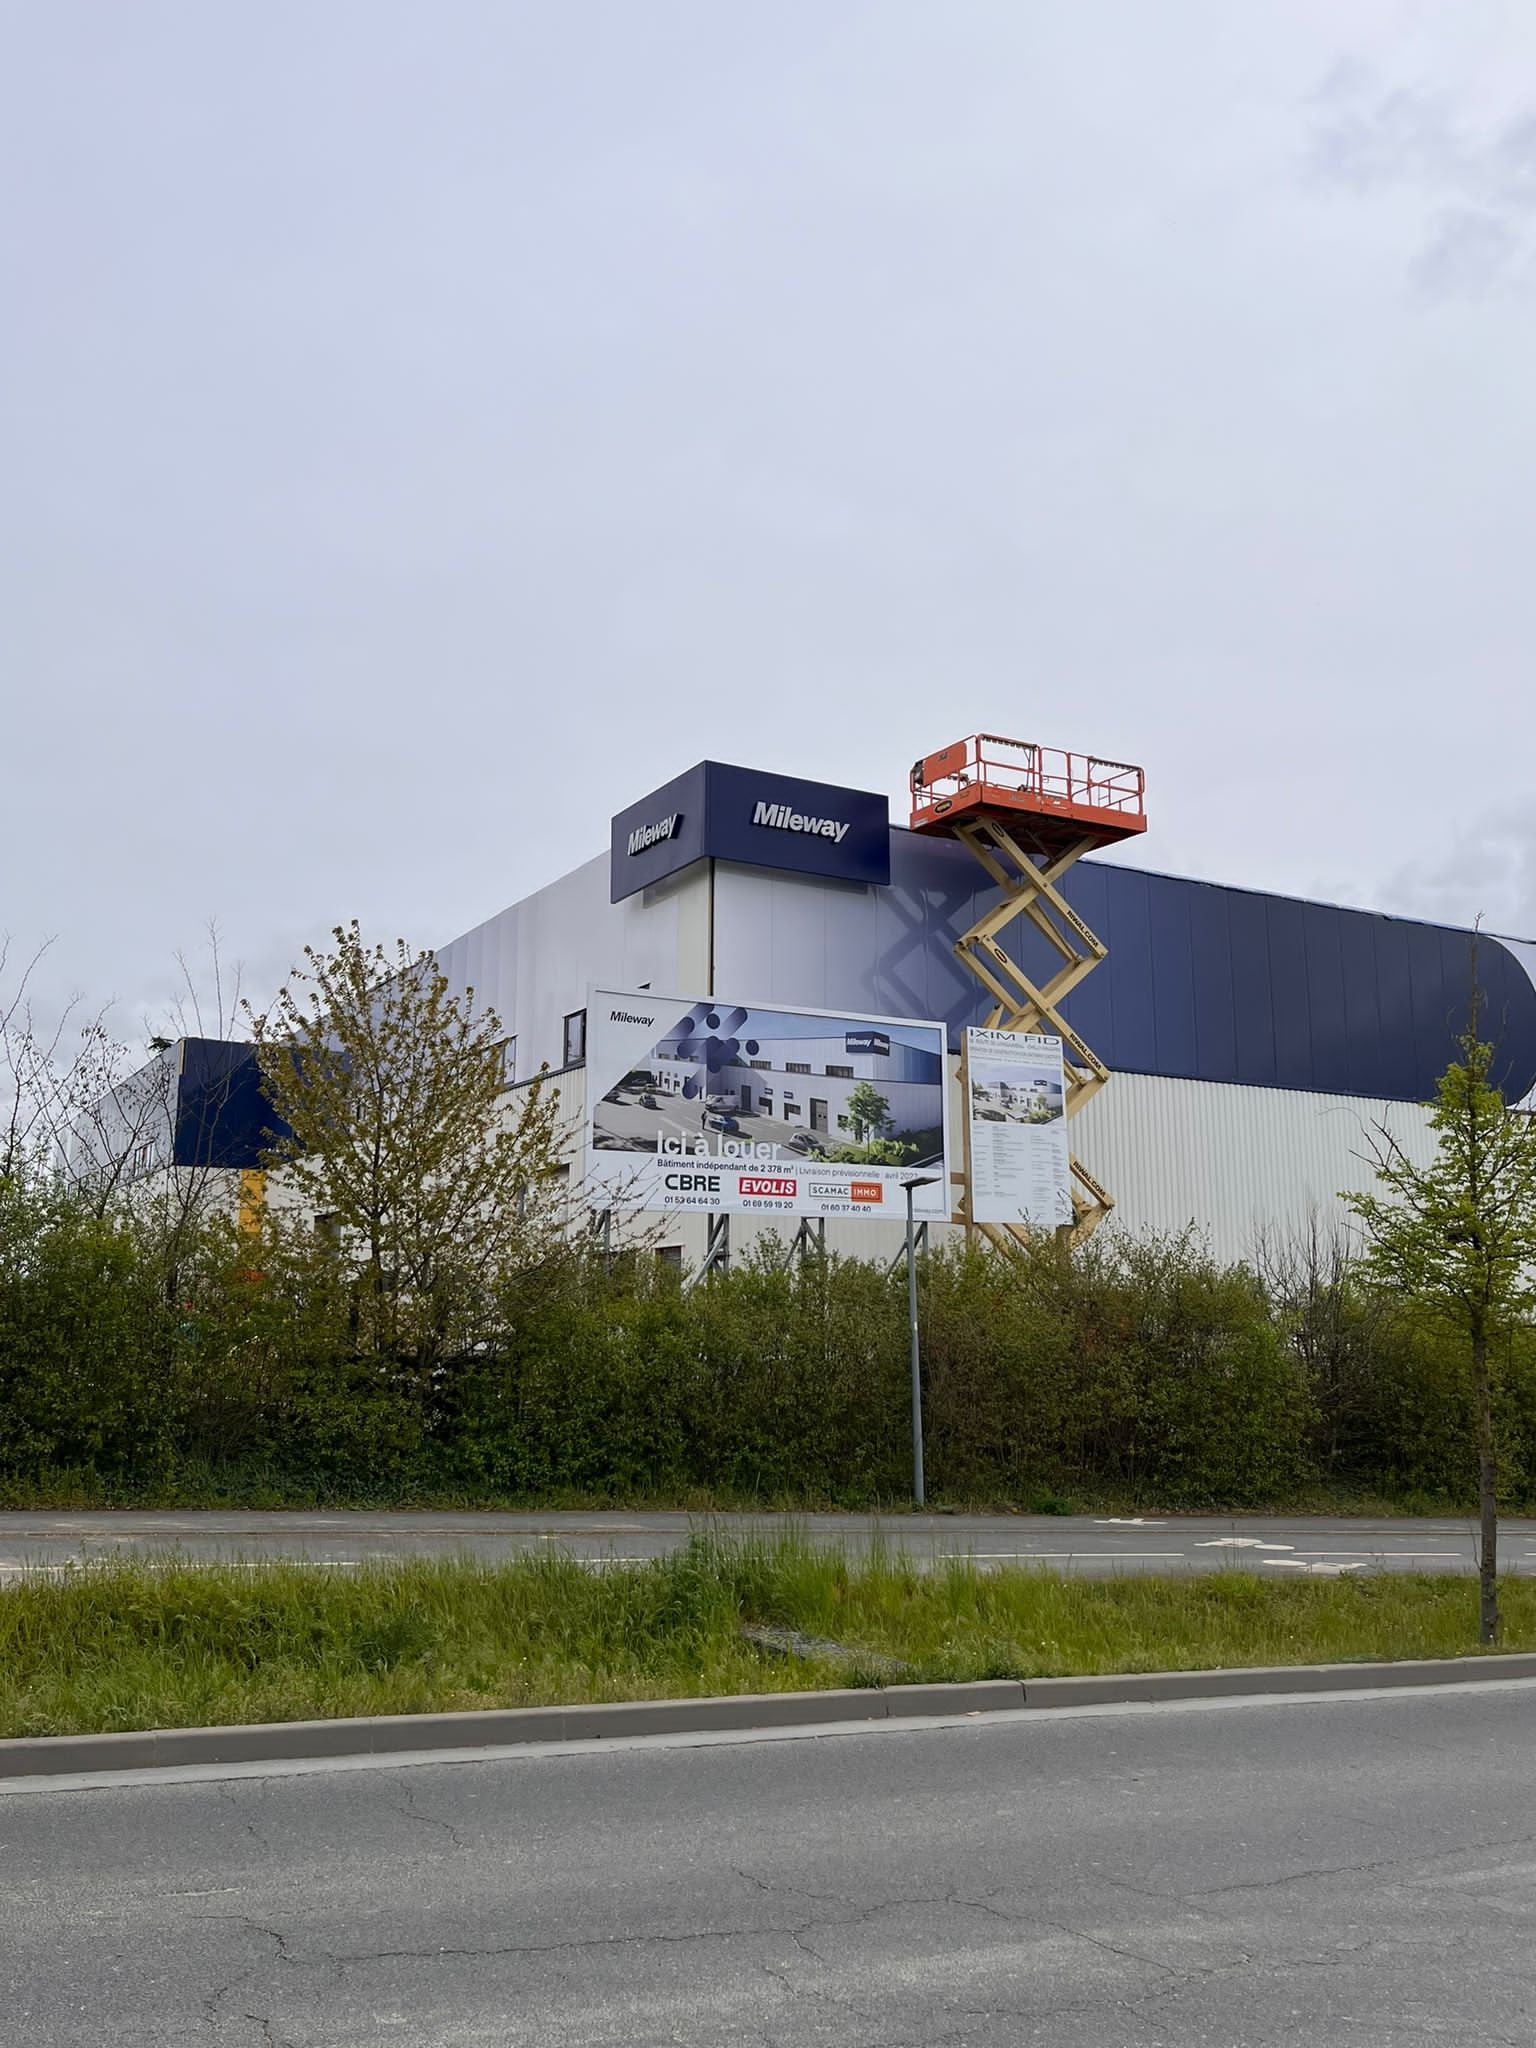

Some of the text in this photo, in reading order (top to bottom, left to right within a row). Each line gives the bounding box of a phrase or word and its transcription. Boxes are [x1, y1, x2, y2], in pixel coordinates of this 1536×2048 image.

[753, 801, 850, 843] Mileway
[627, 812, 678, 856] Mileway
[1067, 910, 1099, 947] RIWAL.COM
[610, 1011, 655, 1028] Mileway
[1070, 1032, 1102, 1071] RIWAL.COM
[657, 1130, 782, 1160] Ici à louer
[657, 1158, 695, 1169] Bâtiment
[696, 1160, 747, 1172] indépendant
[748, 1163, 759, 1172] de
[760, 1164, 766, 1173] 2
[767, 1164, 782, 1173] 378
[799, 1167, 831, 1177] Livraison
[832, 1168, 880, 1179] prévisionnelle
[665, 1174, 721, 1192] CBRE
[741, 1180, 795, 1194] EVOLIS
[1073, 1160, 1106, 1198] RIWAL.COM
[664, 1195, 673, 1204] 01
[686, 1196, 697, 1205] 64
[698, 1196, 708, 1205] 64
[709, 1197, 721, 1205] 30
[812, 1185, 878, 1197] SCAMAC IMMO
[742, 1199, 751, 1207] 01
[783, 1201, 794, 1209] 20
[820, 1203, 829, 1211] 01
